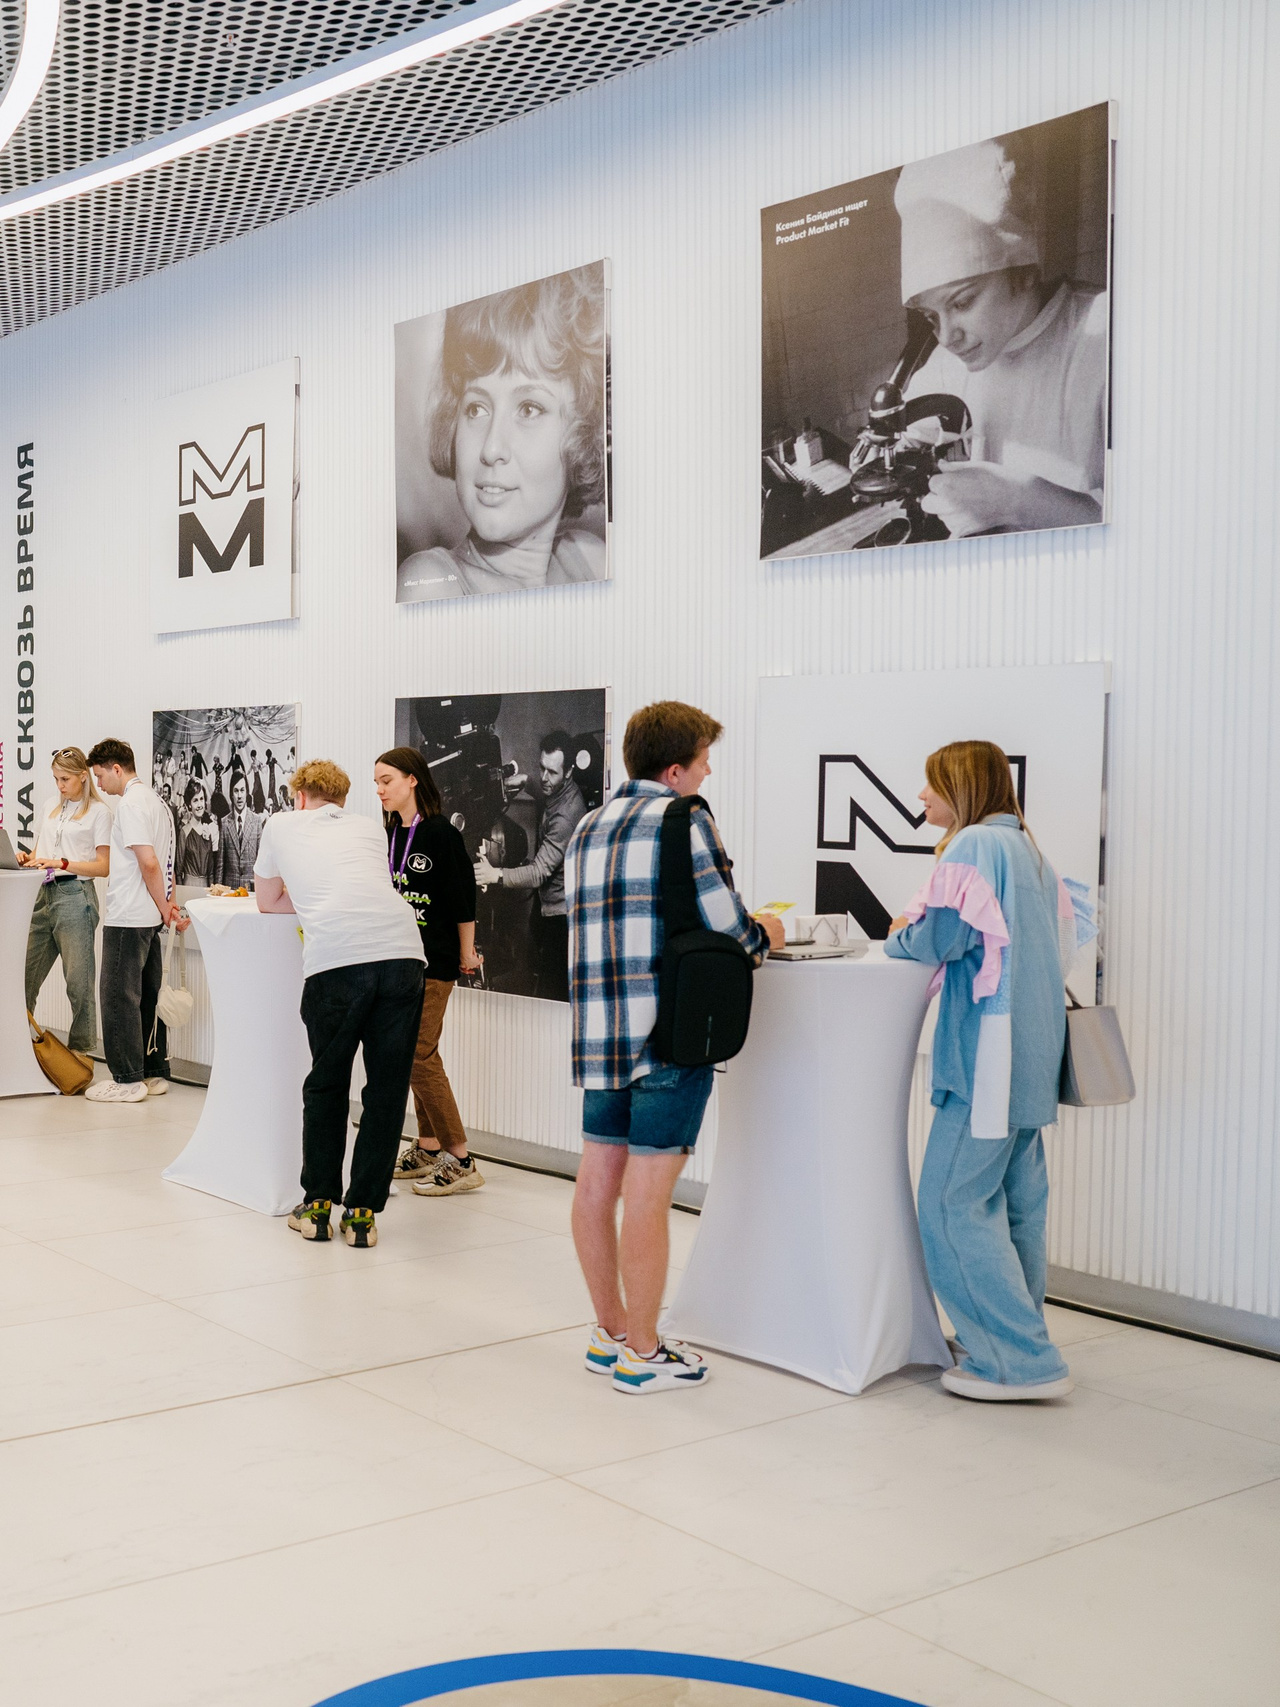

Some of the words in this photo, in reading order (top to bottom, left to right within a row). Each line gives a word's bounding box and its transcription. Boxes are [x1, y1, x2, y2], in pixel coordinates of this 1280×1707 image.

[775, 219, 805, 232] Ксения
[806, 206, 844, 223] Байдина
[844, 199, 868, 213] ищет
[775, 227, 806, 245] Product
[807, 221, 838, 236] Market
[839, 216, 850, 228] Fit
[17, 441, 35, 593] ВРЕМЯ
[17, 603, 35, 771] СКВОЗЬ
